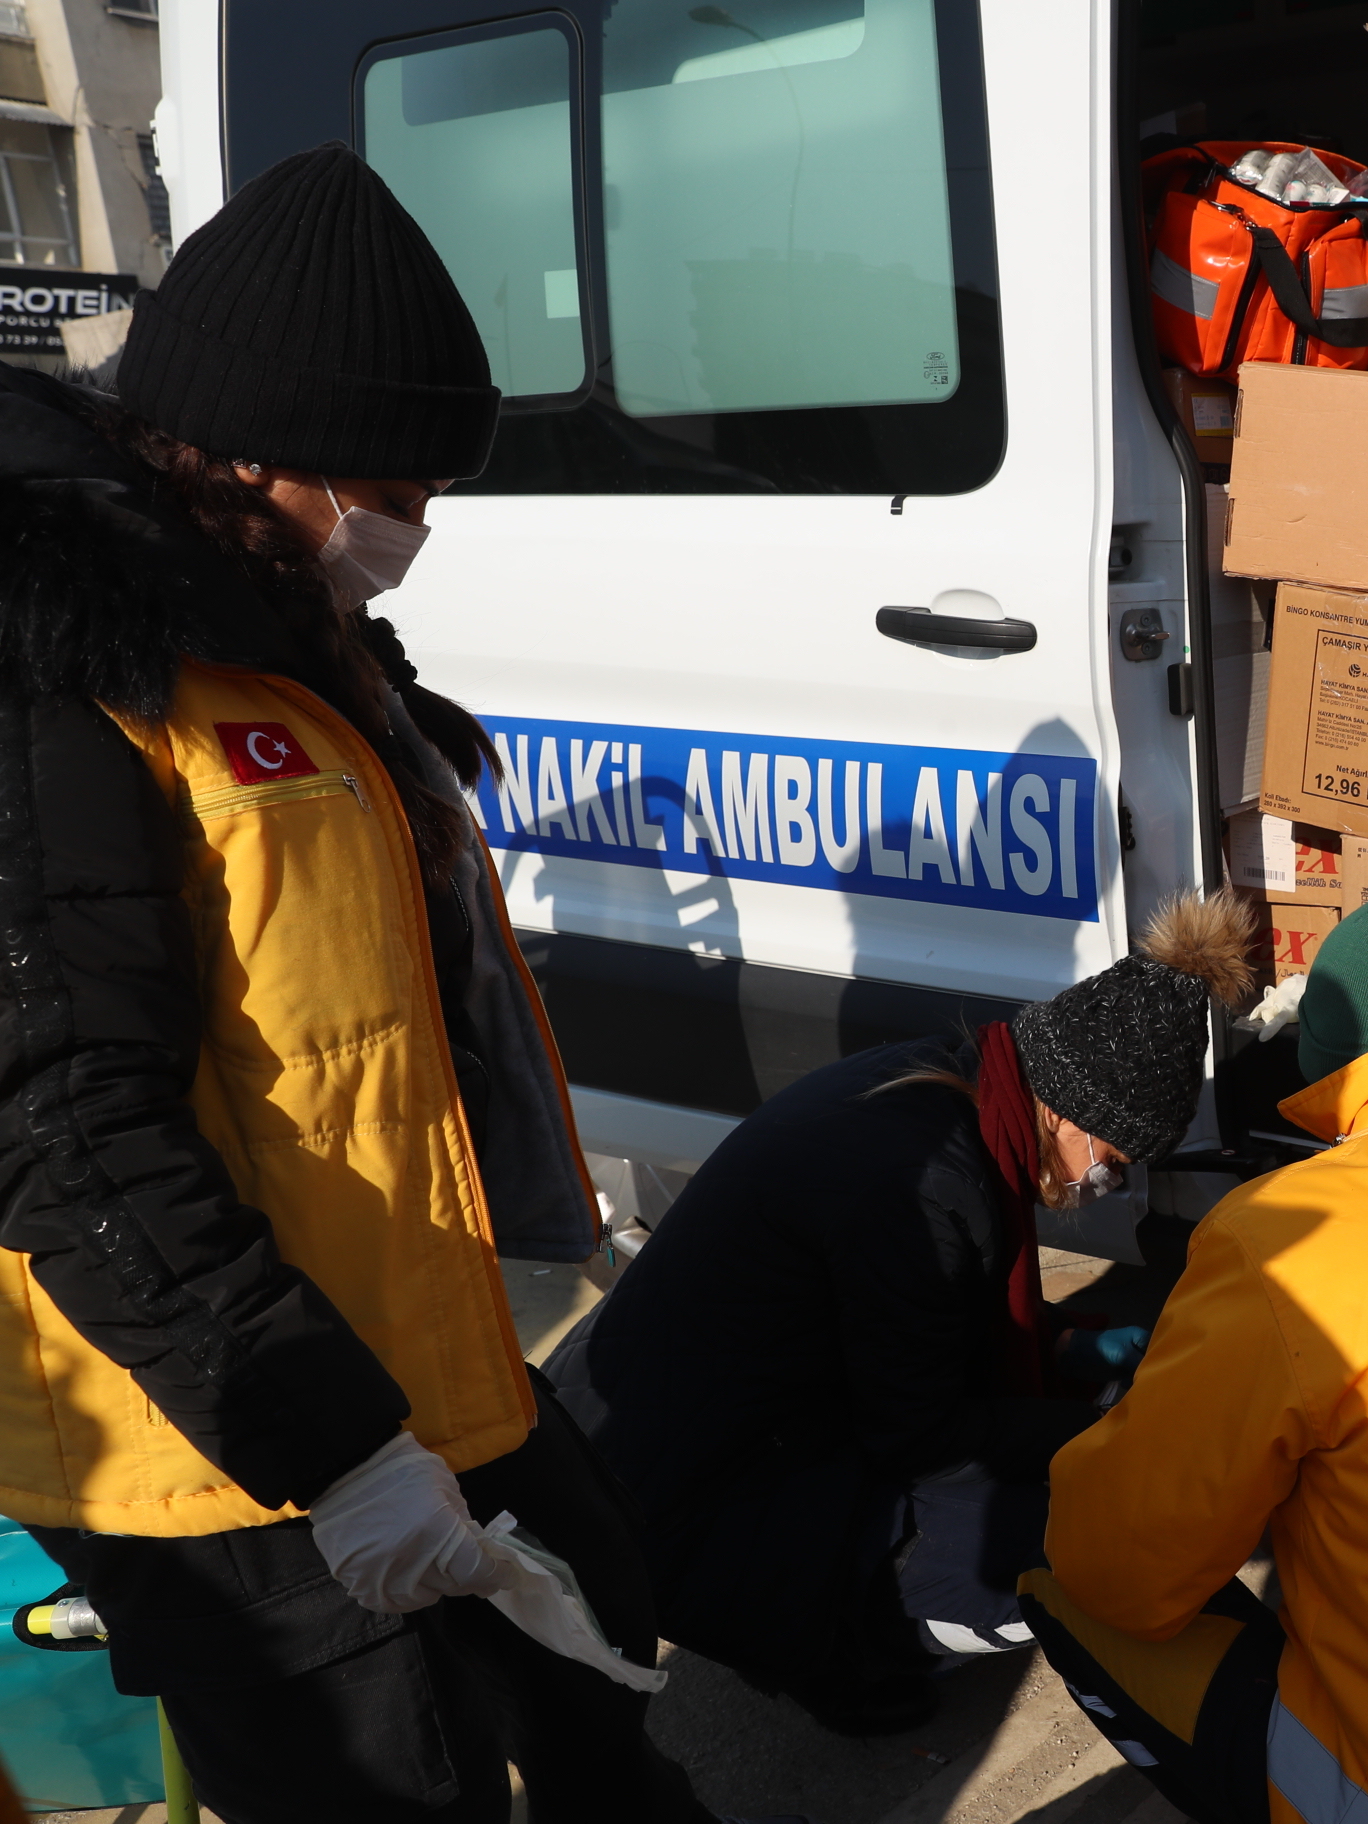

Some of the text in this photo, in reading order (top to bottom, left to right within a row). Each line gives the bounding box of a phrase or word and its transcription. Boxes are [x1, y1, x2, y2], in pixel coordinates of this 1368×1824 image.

[1310, 609, 1354, 624] KONSANTRE
[1322, 636, 1361, 652] ÇAMAŞIR
[1320, 679, 1338, 688] HAYAT
[1318, 709, 1334, 718] HAYAT
[1336, 764, 1349, 775] Net
[1314, 773, 1361, 798] 12,96
[1264, 792, 1275, 802] Koli
[682, 747, 1079, 899] AMBULANSI
